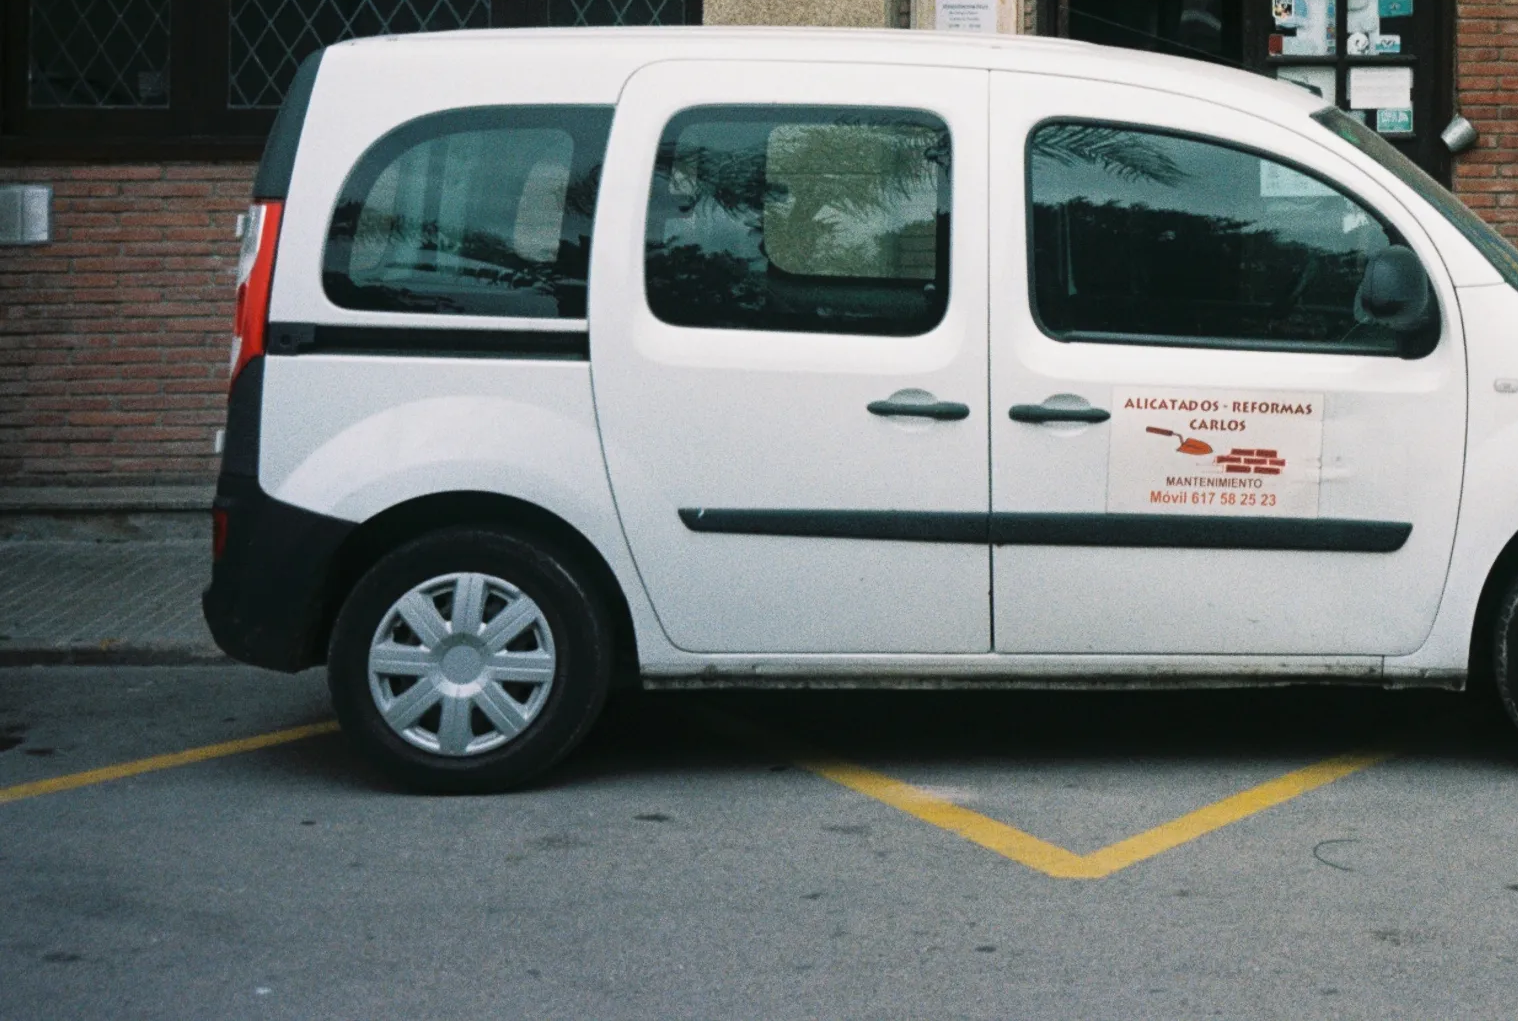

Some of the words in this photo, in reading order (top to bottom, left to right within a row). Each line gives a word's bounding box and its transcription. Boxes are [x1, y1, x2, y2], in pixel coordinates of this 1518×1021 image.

[1124, 398, 1219, 412] ALICATADOS
[1232, 402, 1313, 415] REFORMAS
[1190, 419, 1246, 432] CARLOS
[1166, 477, 1262, 488] MANTENIMIENTO
[1150, 490, 1187, 504] Móvil
[1191, 492, 1215, 505] 617
[1220, 492, 1236, 505] 58
[1240, 493, 1256, 506] 25
[1260, 494, 1276, 506] 23
